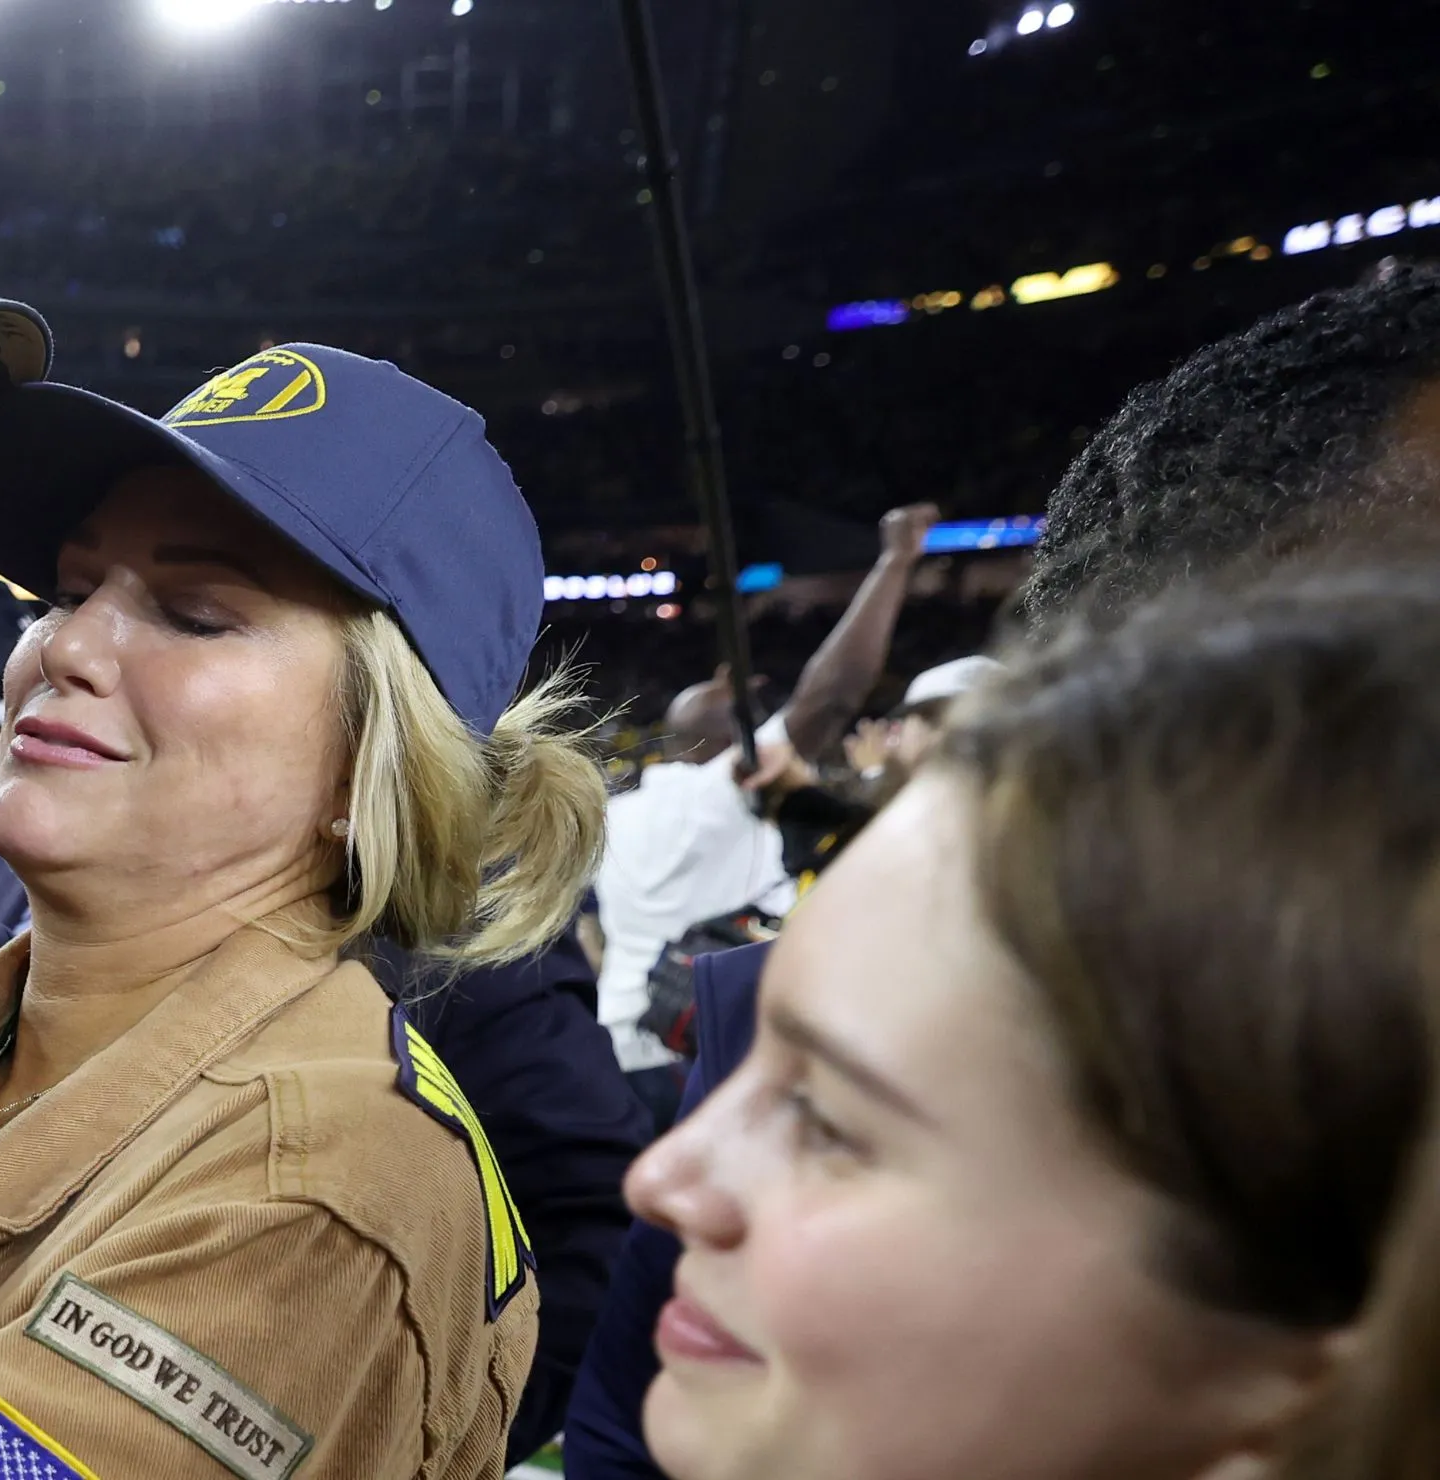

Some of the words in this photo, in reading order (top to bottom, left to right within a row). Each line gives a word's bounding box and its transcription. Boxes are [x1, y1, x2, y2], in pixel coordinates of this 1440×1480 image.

[51, 1299, 92, 1335] IN
[90, 1322, 155, 1372] GOD
[154, 1356, 203, 1405] WE
[200, 1391, 286, 1468] TRUST
